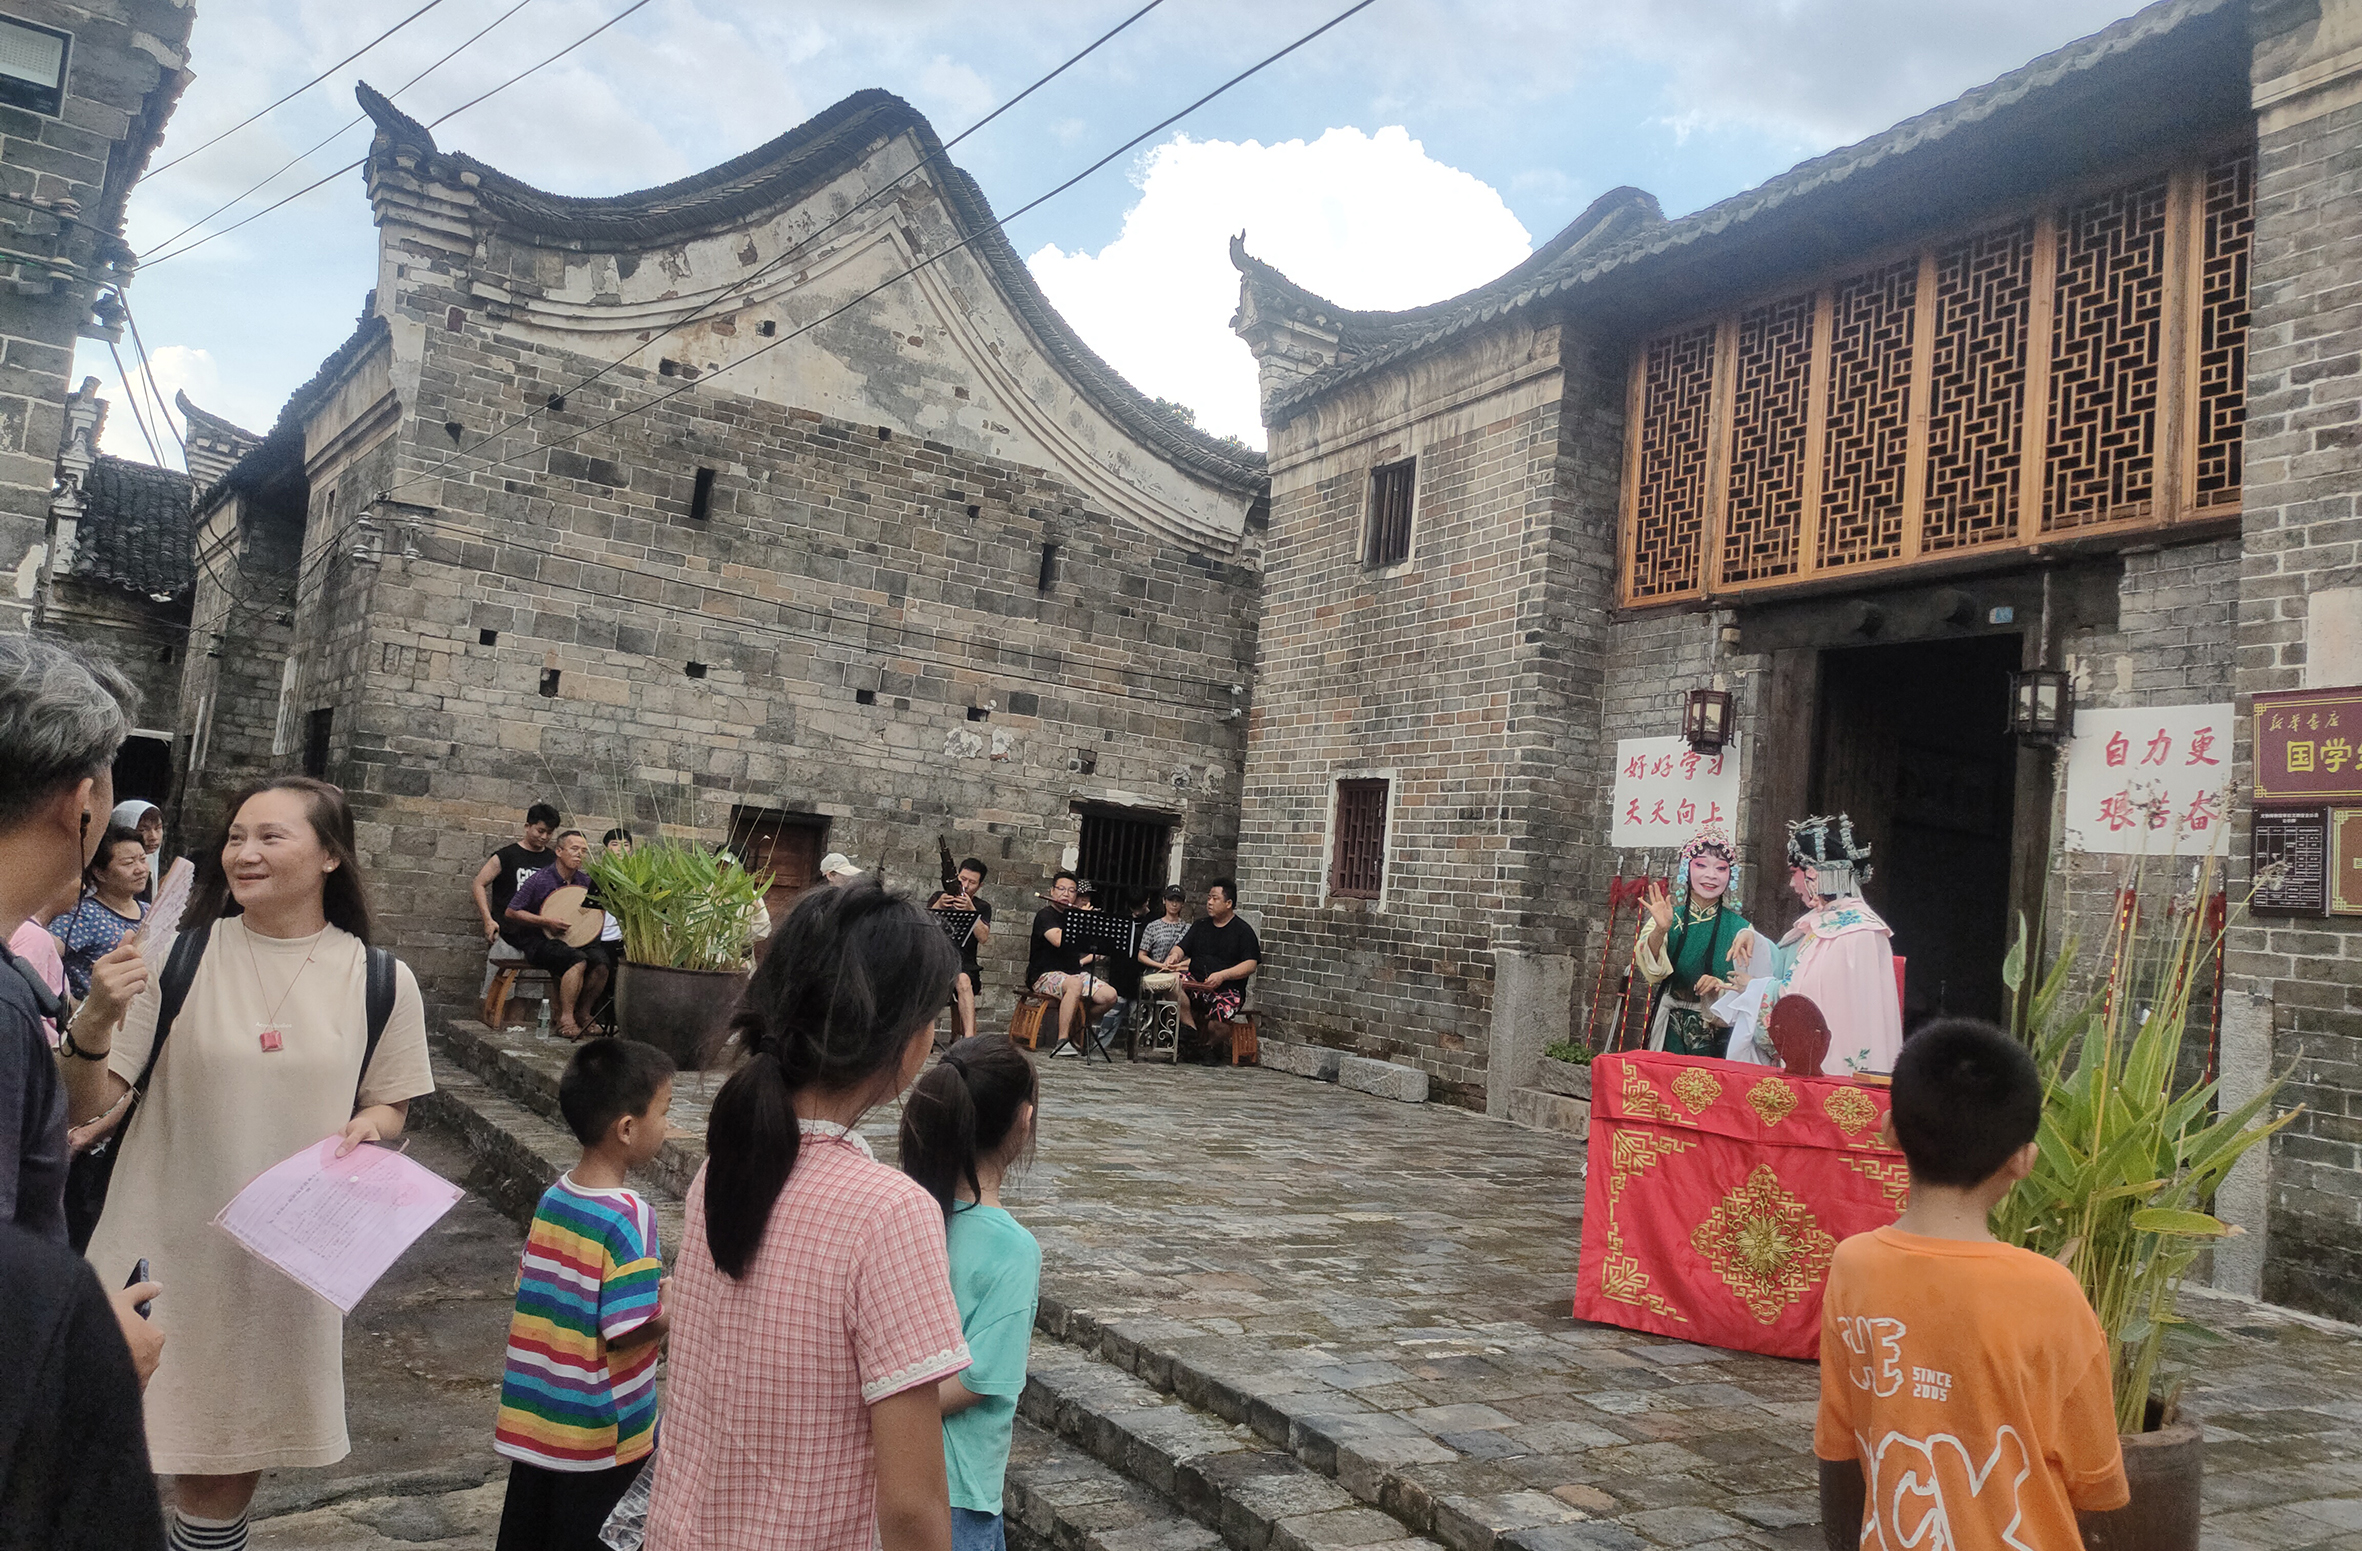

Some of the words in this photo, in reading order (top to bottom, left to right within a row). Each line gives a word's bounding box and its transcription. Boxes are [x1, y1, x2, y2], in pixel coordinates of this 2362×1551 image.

[2105, 726, 2221, 768] 自力更
[1623, 750, 1725, 781] 好好学习
[1623, 797, 1725, 826] 天天向上
[1911, 1366, 1953, 1389] SINCE
[1912, 1383, 1948, 1402] 2005
